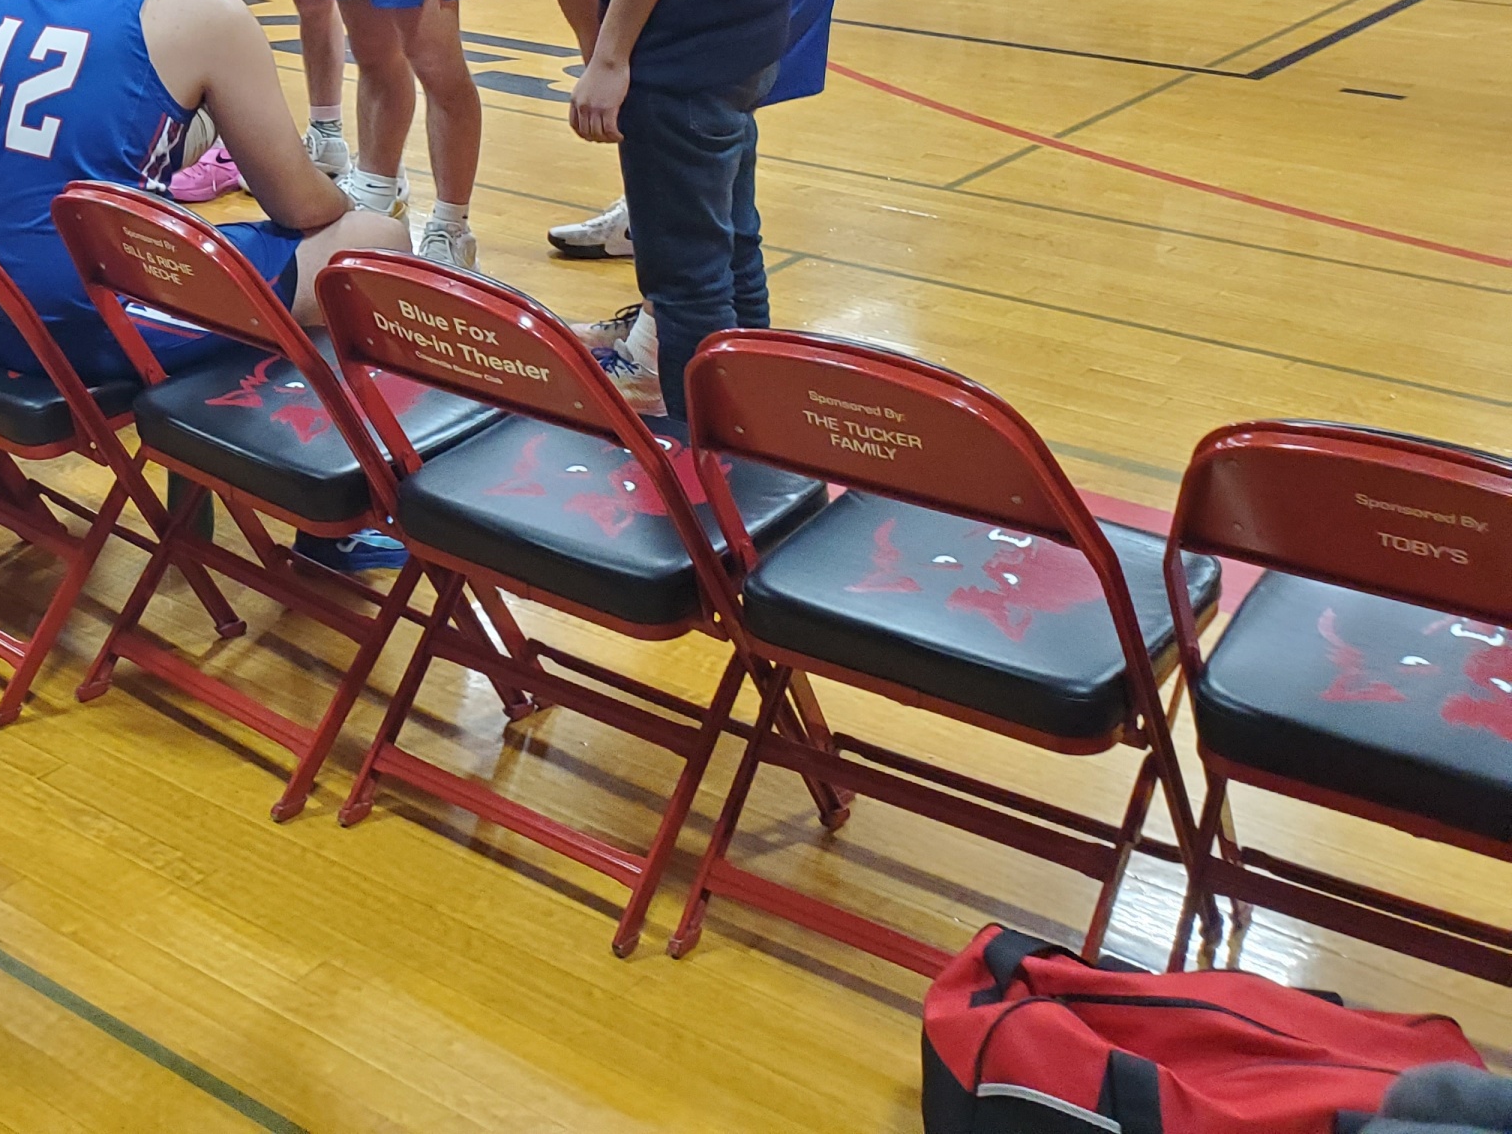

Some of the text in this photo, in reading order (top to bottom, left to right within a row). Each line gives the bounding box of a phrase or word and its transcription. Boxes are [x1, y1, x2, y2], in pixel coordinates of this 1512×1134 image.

[398, 299, 500, 346] Blue Fox
[456, 342, 550, 382] Theater
[808, 390, 882, 417] Sponsored
[802, 410, 923, 450] THE TUCKER
[830, 433, 897, 461] FAMILY
[1354, 492, 1456, 525] Sponsored
[1377, 532, 1470, 565] TOBY'S
